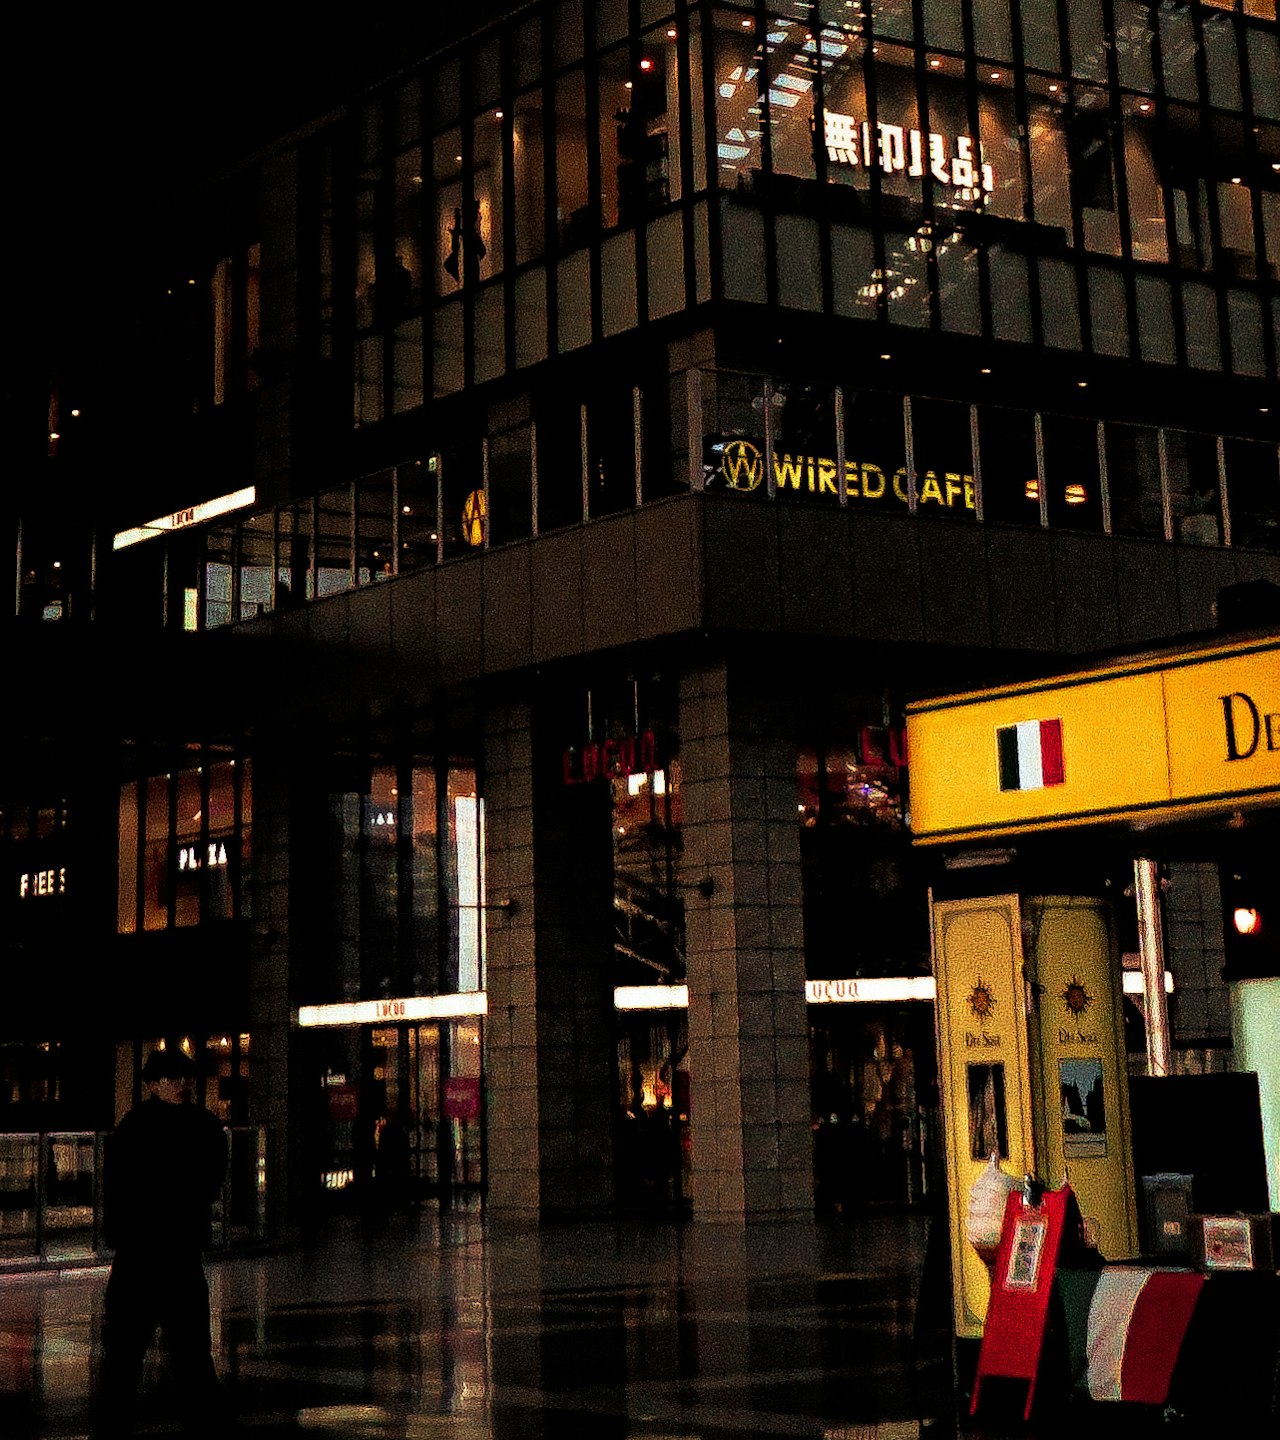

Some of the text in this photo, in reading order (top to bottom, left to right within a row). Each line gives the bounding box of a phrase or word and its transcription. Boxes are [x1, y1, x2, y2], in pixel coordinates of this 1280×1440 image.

[811, 107, 995, 193] 無印良品
[771, 450, 887, 501] WIRED
[178, 841, 228, 872] PLZA
